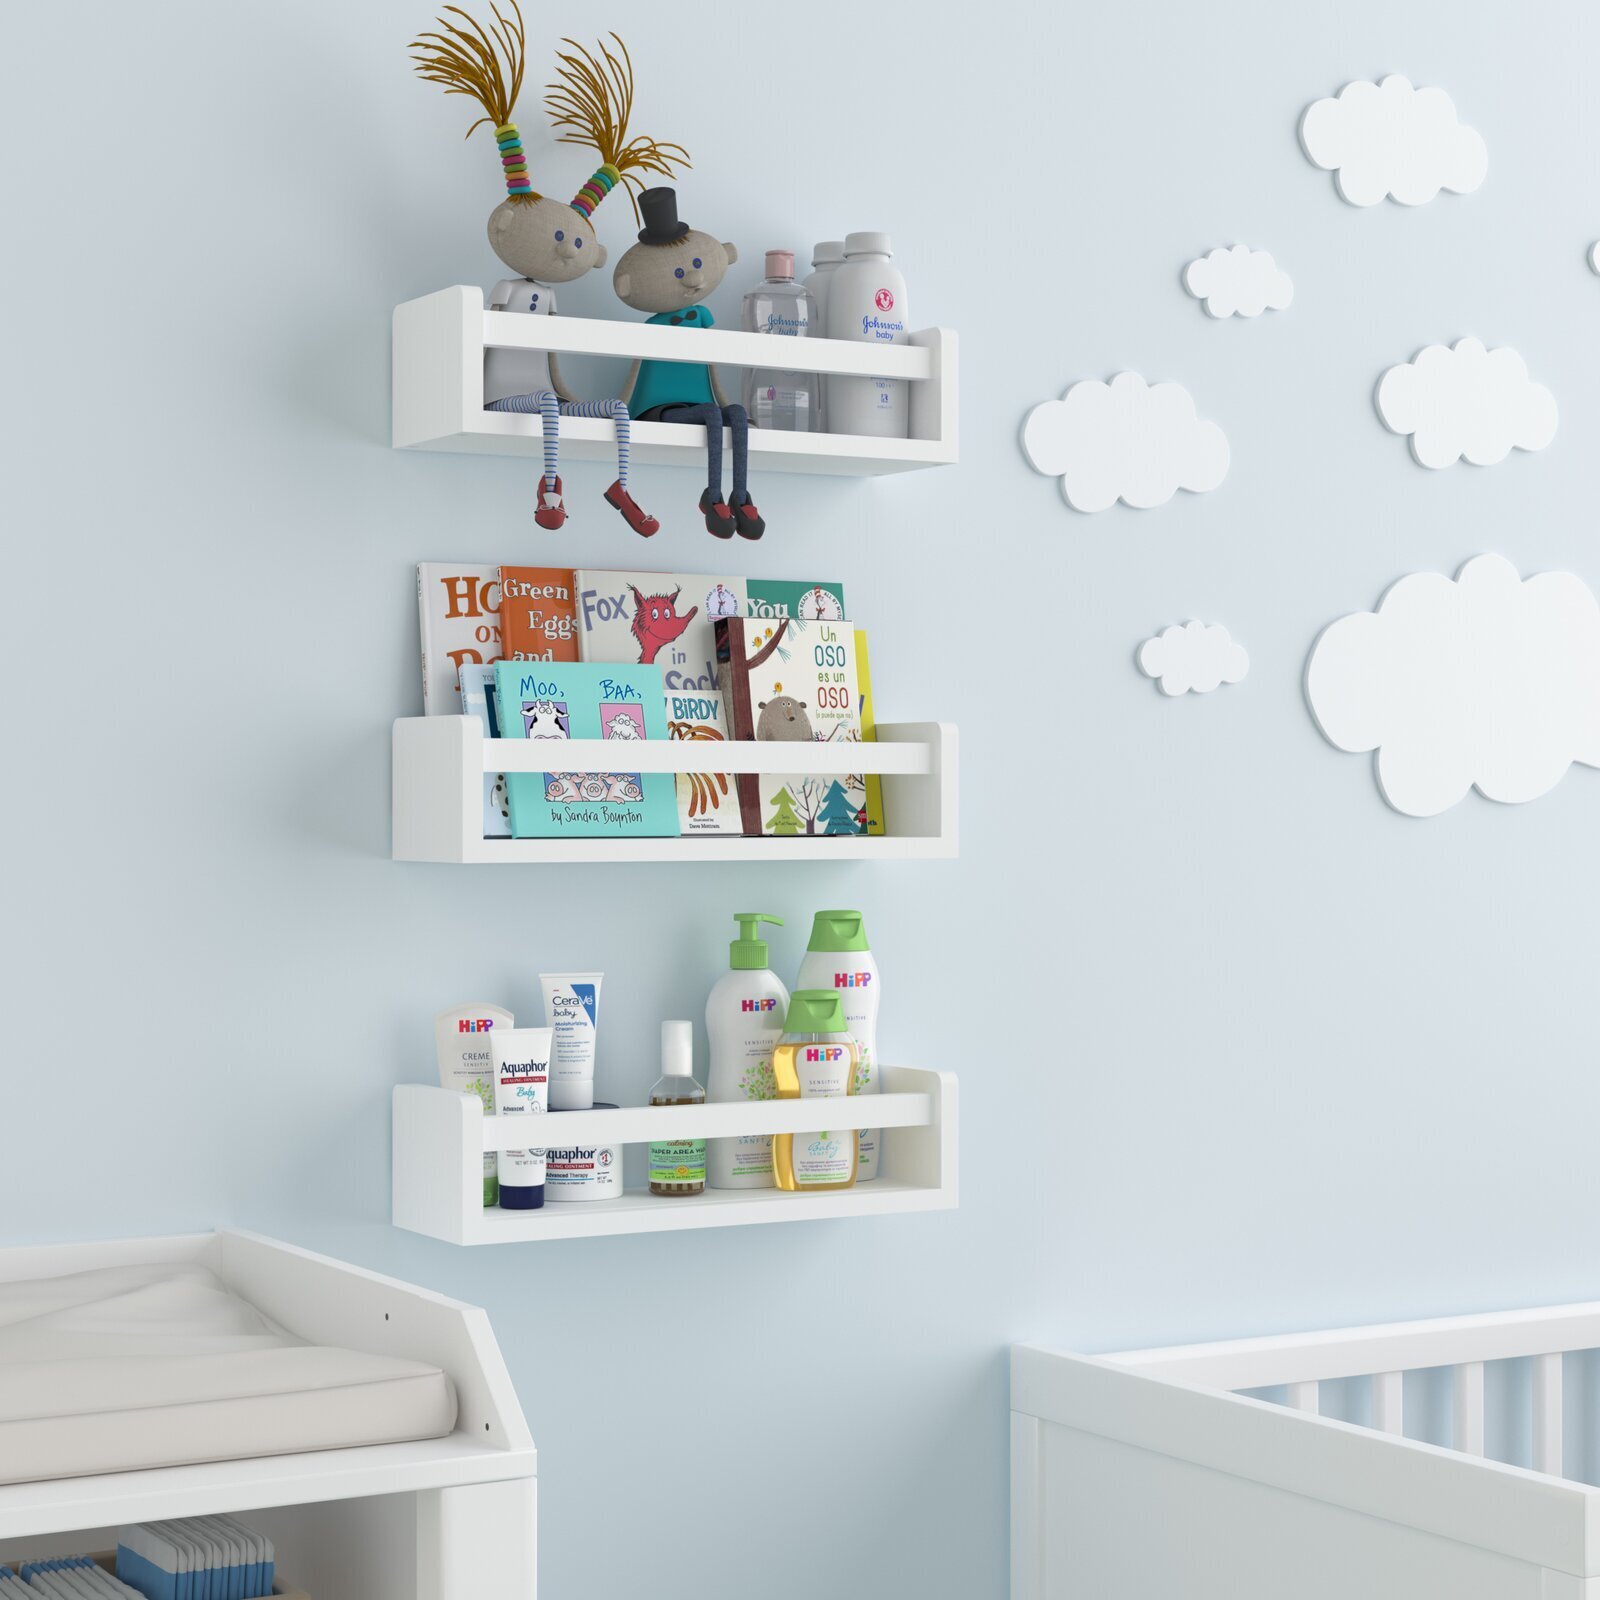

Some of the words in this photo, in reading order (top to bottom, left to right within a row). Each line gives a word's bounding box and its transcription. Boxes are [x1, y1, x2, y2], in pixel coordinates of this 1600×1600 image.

[863, 315, 903, 334] Johnson's
[876, 330, 894, 341] baby
[441, 577, 500, 618] HO
[503, 578, 569, 601] Green
[748, 598, 790, 619] You
[528, 611, 579, 641] Eggs
[820, 626, 837, 642] Un
[512, 649, 553, 662] and
[672, 647, 687, 665] in
[814, 645, 846, 667] OSO
[665, 661, 719, 690] Sock
[818, 672, 829, 683] es
[833, 672, 845, 683] un
[818, 687, 848, 708] OSO
[551, 808, 563, 825] by
[564, 806, 599, 823] Sandra
[600, 806, 643, 828] Boynton
[553, 1009, 577, 1019] baby
[462, 1053, 491, 1061] CREME
[500, 1059, 548, 1077] Aquaphor
[517, 1086, 536, 1100] Baby
